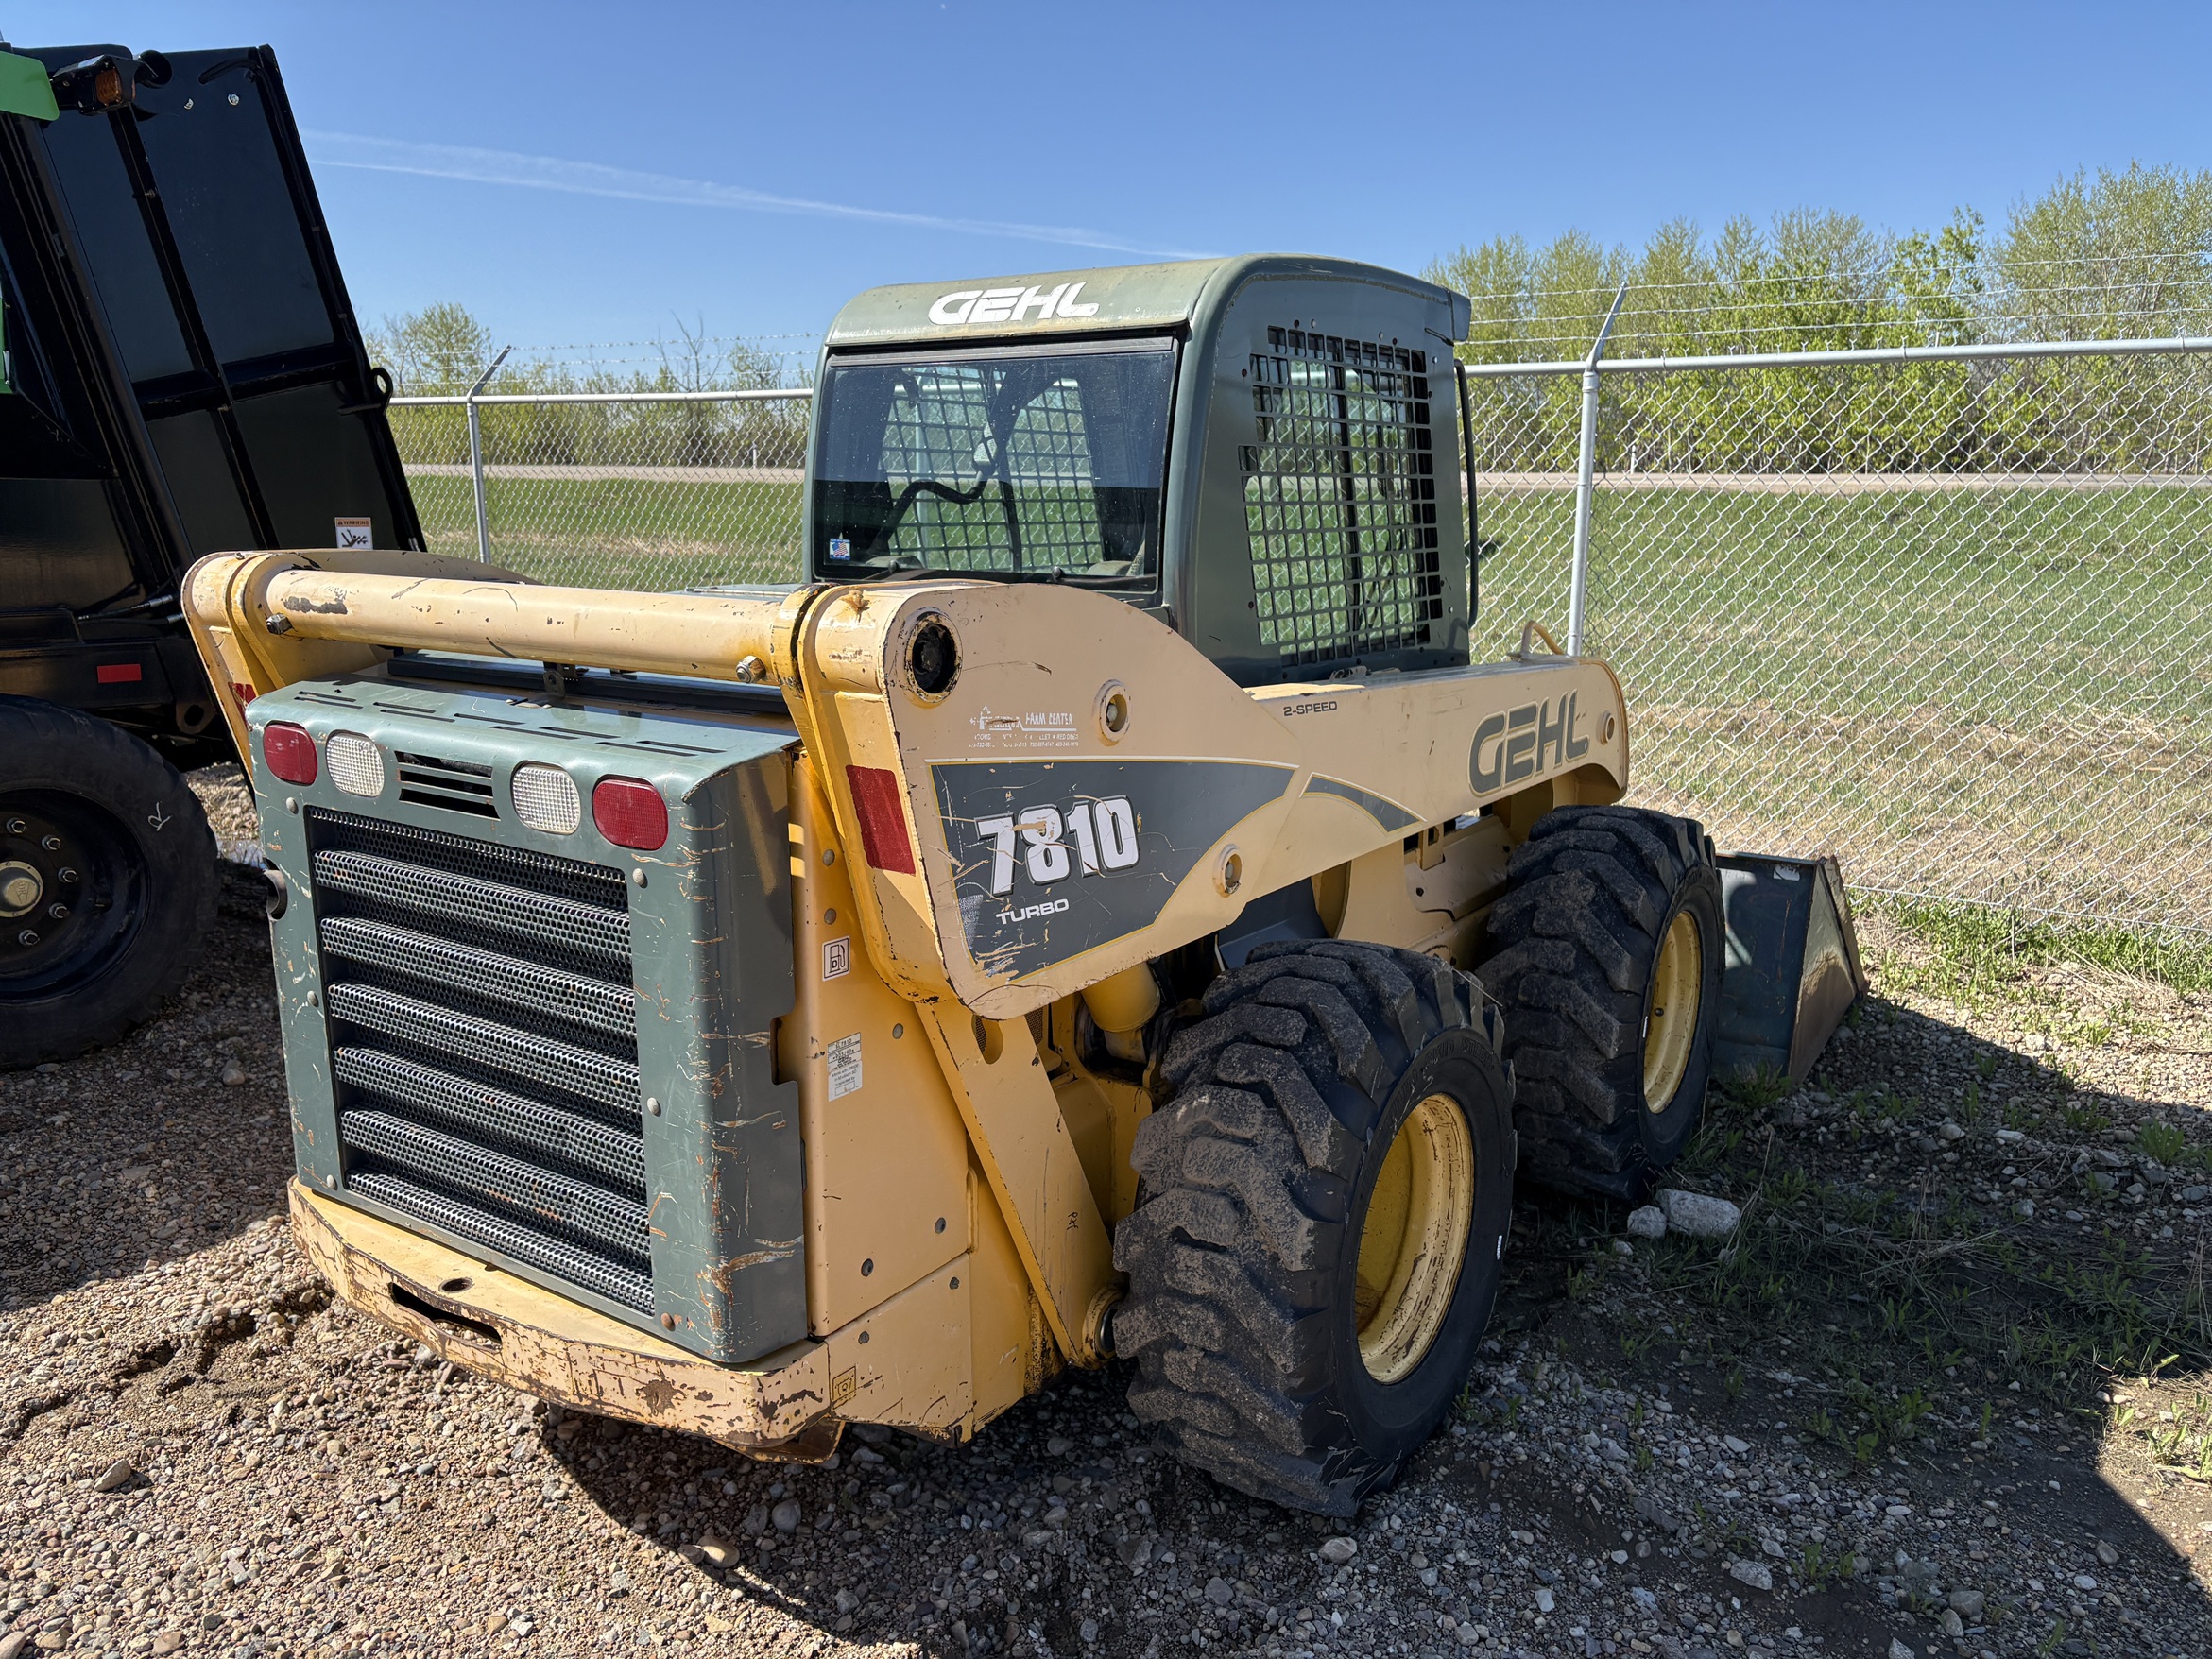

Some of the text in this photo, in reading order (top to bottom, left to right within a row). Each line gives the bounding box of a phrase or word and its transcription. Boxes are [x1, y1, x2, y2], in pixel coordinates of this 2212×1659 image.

[928, 282, 1100, 325] GEHL
[1283, 700, 1338, 716] 2-SPEED
[1468, 689, 1590, 797] GEHL
[974, 795, 1140, 898] 7810
[996, 898, 1070, 925] TURBO
[1461, 1036, 1495, 1071] STEER
